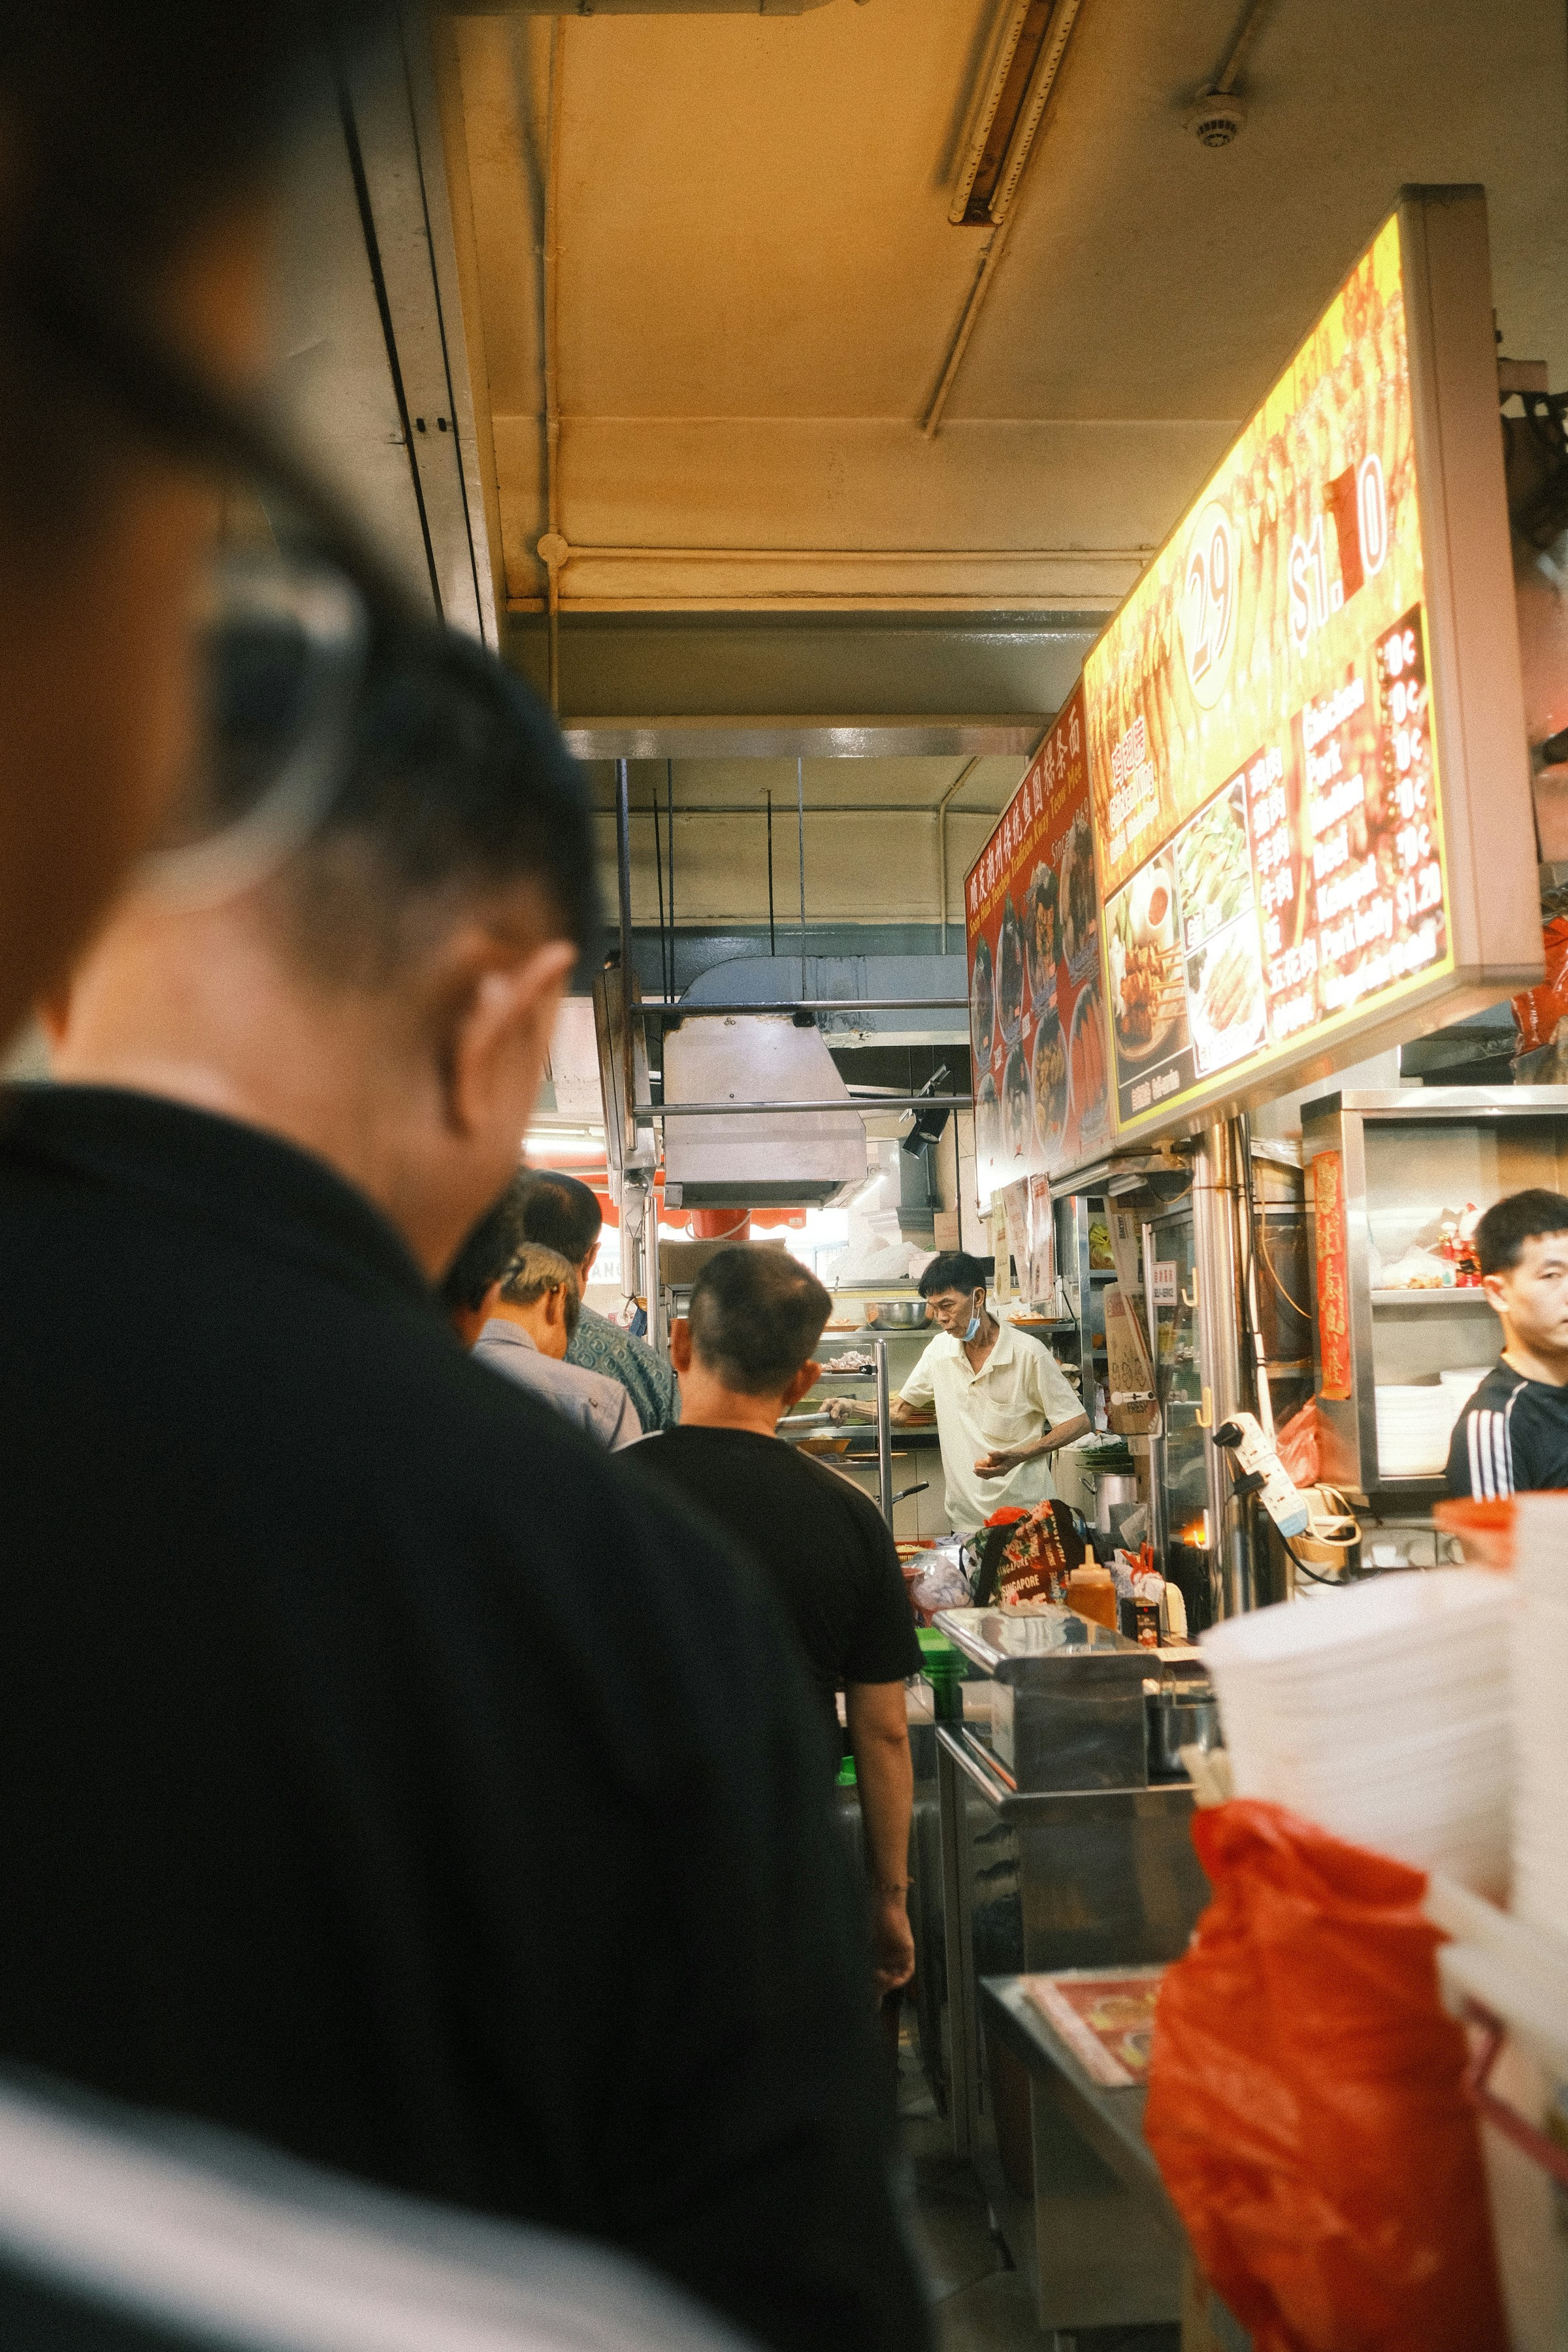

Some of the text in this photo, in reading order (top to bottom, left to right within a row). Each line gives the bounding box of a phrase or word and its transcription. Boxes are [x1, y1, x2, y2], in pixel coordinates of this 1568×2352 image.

[1186, 523, 1232, 685] 29
[1302, 677, 1364, 753] Chicken
[1110, 784, 1135, 831] Chicken
[1135, 760, 1154, 798] Wing
[1306, 738, 1343, 792] Pork
[992, 870, 1010, 907] Teochew
[1034, 810, 1049, 845] Kway
[1050, 784, 1066, 818] Teow
[1067, 760, 1082, 795] Mee
[1051, 828, 1070, 868] Since
[1262, 866, 1294, 915] 牛肉
[1313, 823, 1348, 879] Beef
[1268, 938, 1318, 994] 五花肉
[1397, 861, 1441, 924] $1.20
[1002, 1575, 1040, 1595] SINGAPORE
